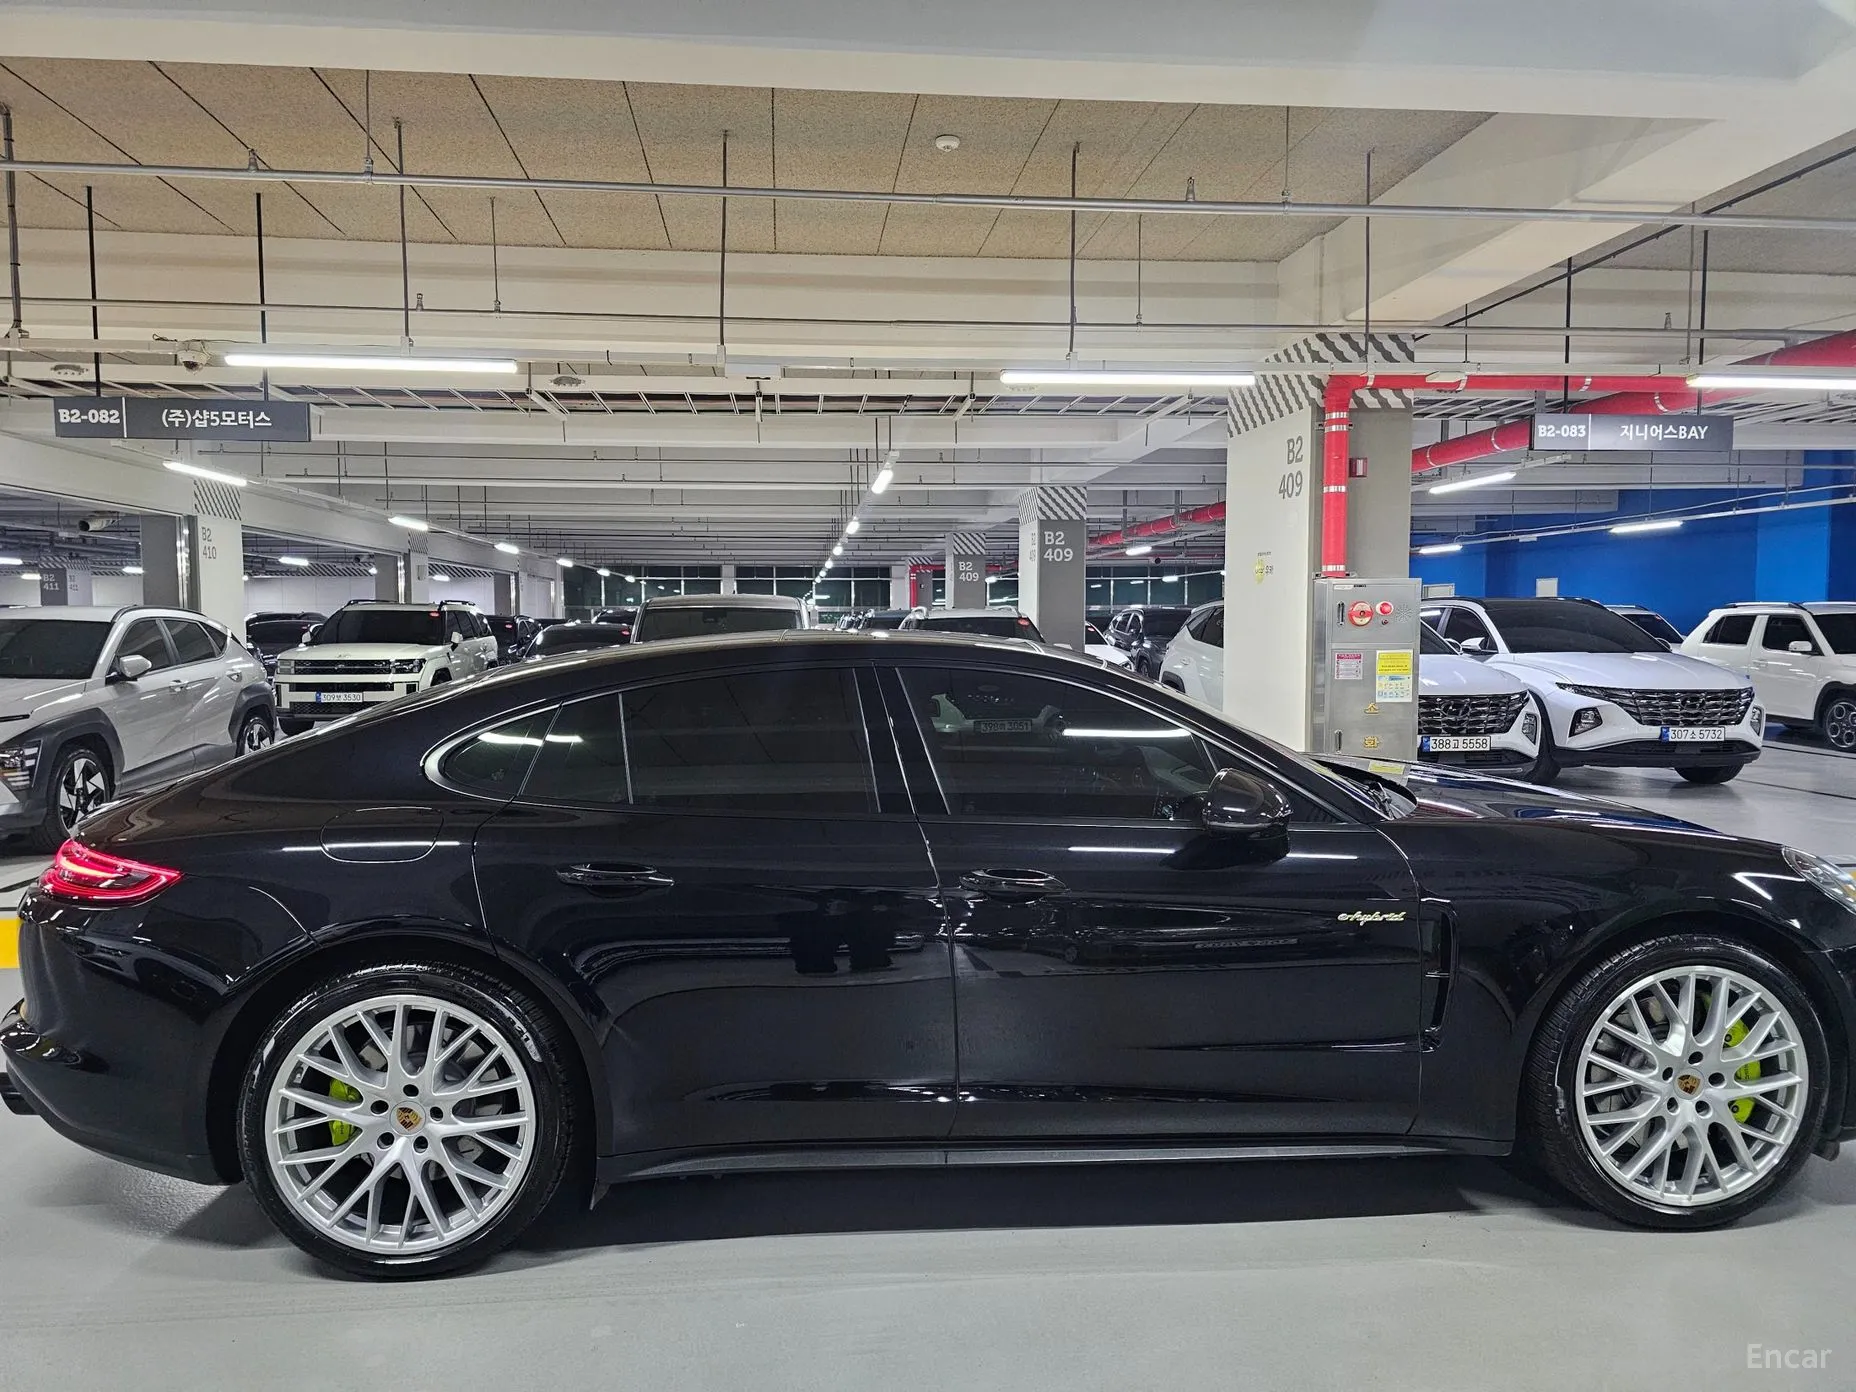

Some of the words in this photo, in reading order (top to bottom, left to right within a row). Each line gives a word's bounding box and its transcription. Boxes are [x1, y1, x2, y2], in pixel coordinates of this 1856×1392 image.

[58, 409, 120, 424] B2-082
[161, 409, 273, 429] (주)샵5모터스
[1538, 425, 1586, 438] B2-083
[1620, 424, 1708, 441] 지니어스BAY
[1286, 435, 1304, 465] B2
[1279, 470, 1303, 500] 409
[201, 526, 212, 542] B2
[1044, 531, 1065, 545] B2
[202, 545, 217, 560] 410
[1043, 548, 1074, 562] 409
[959, 561, 973, 571] B2
[43, 573, 55, 582] B2
[959, 572, 979, 582] 409
[43, 582, 60, 590] 411
[1670, 729, 1696, 740] 307소
[1698, 729, 1722, 740] 5732
[1431, 738, 1459, 750] 388고
[1462, 738, 1488, 749] 5558
